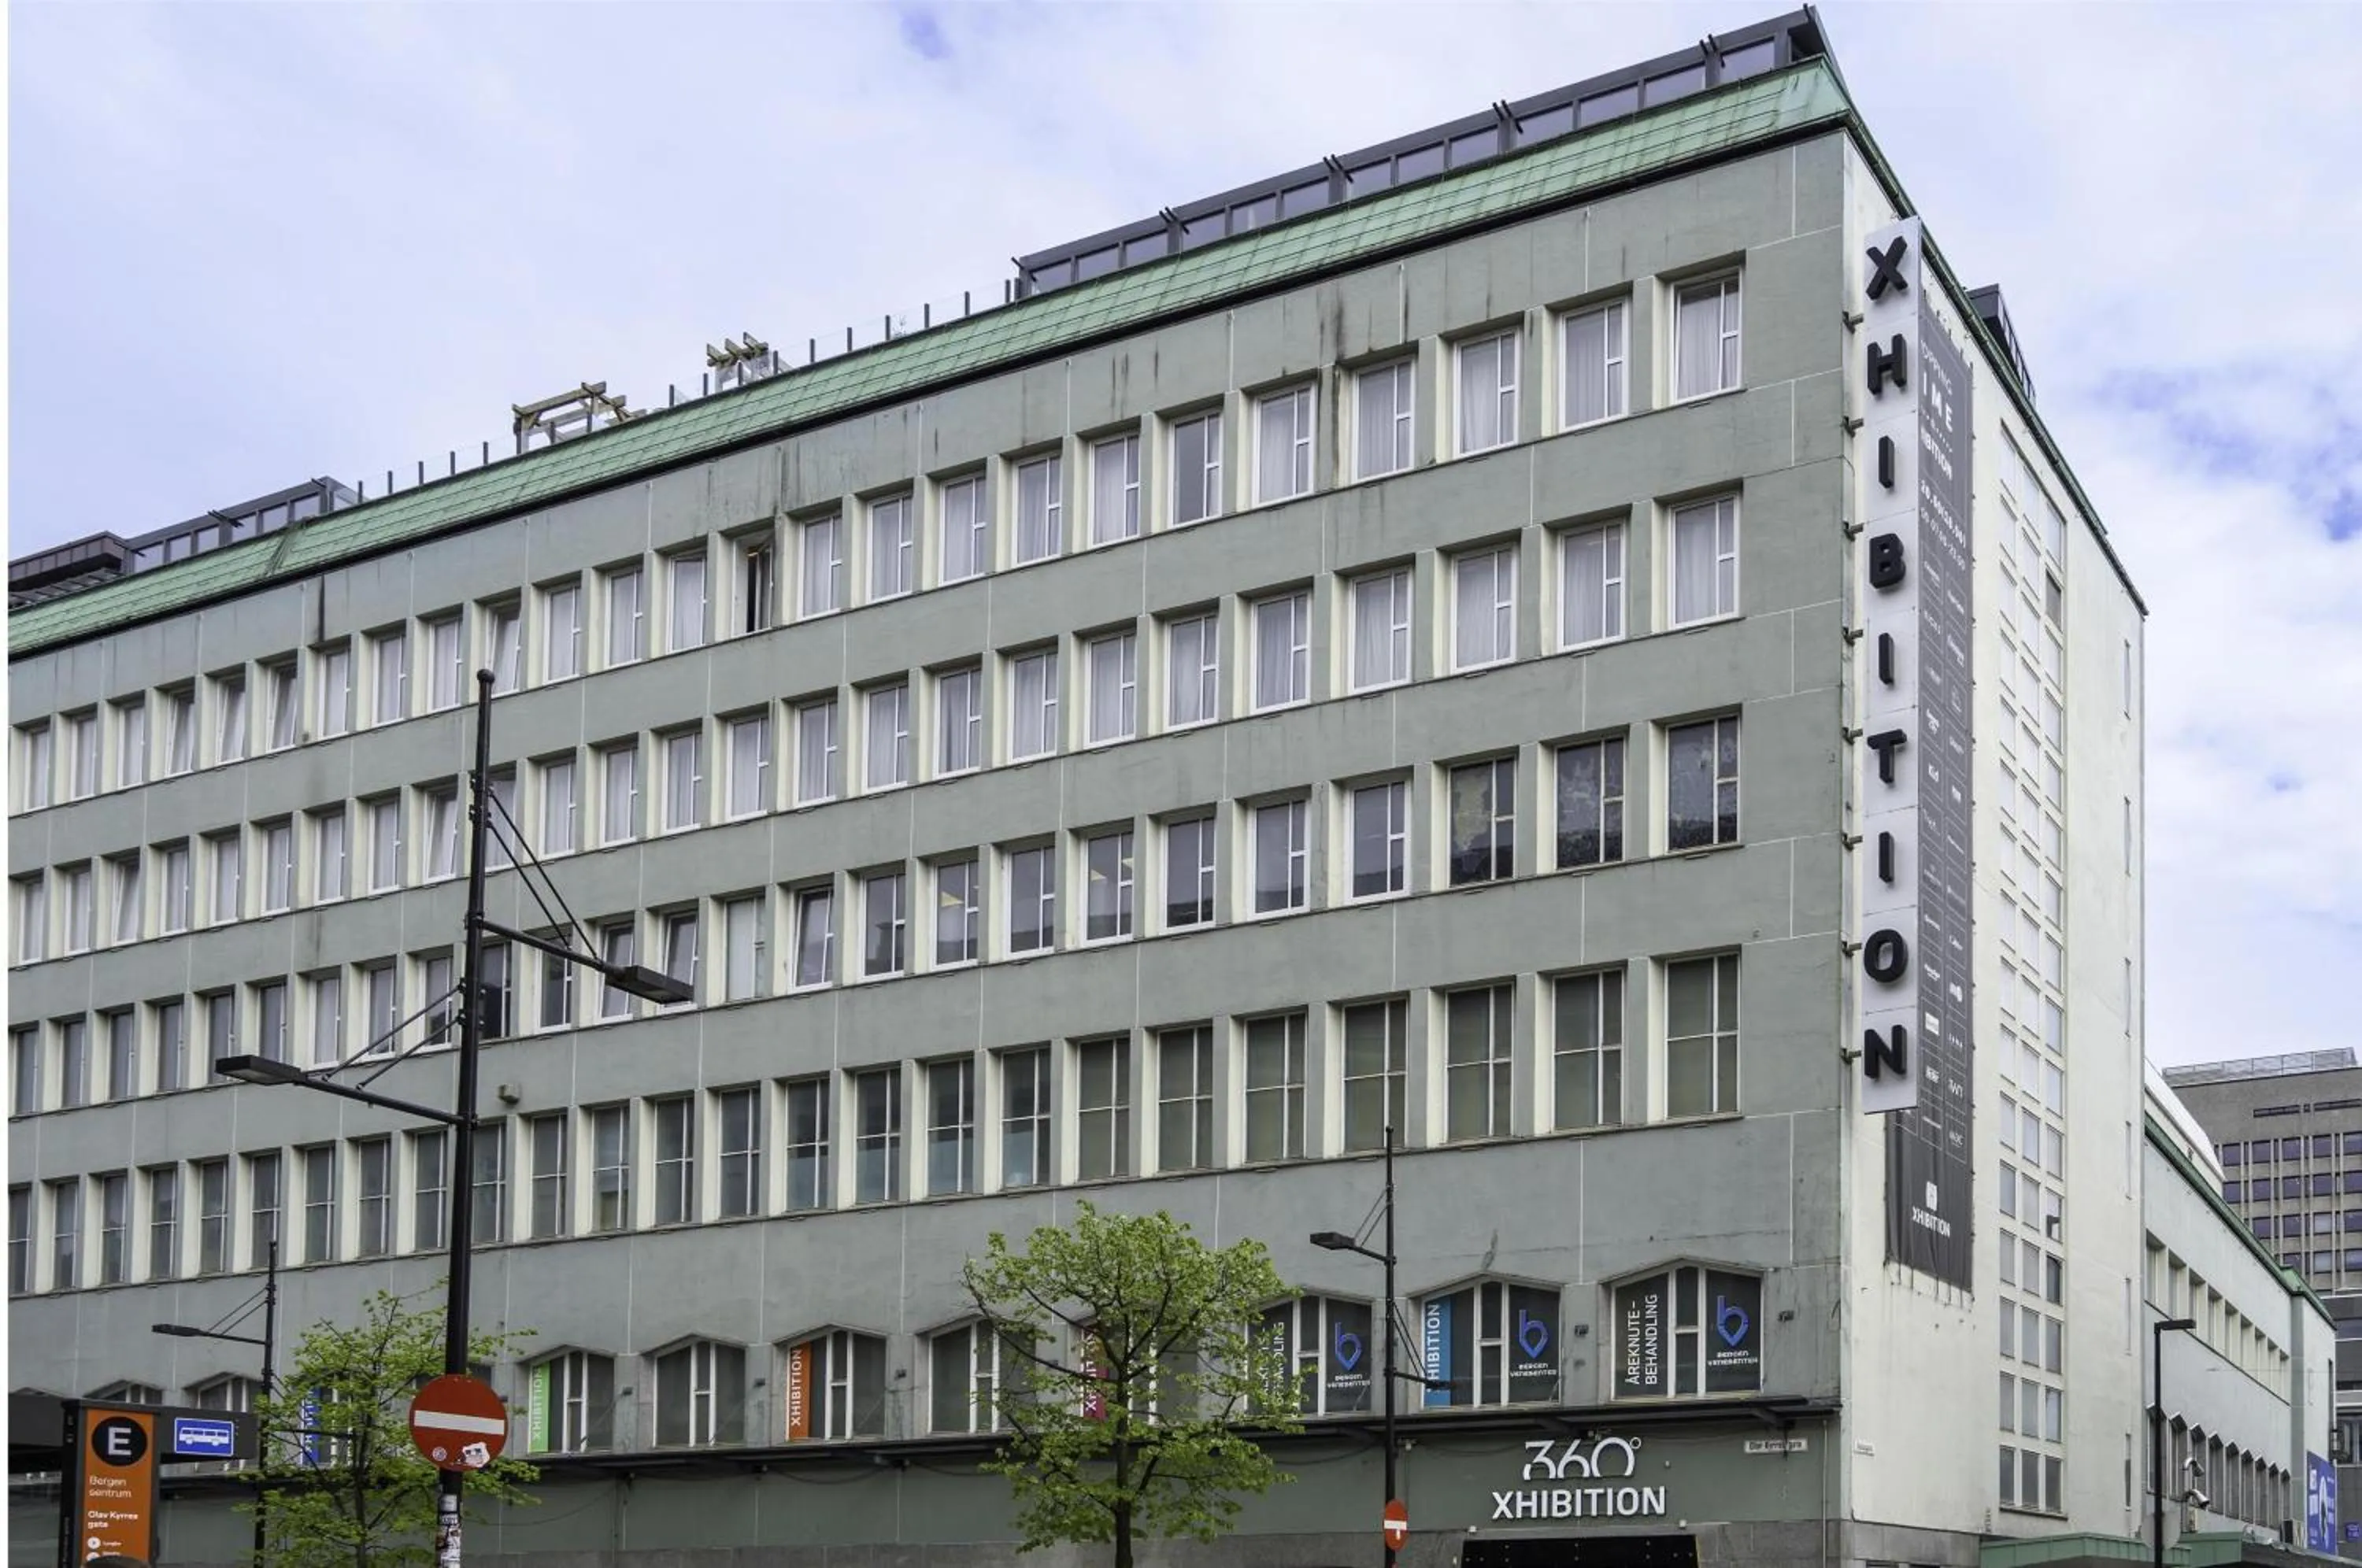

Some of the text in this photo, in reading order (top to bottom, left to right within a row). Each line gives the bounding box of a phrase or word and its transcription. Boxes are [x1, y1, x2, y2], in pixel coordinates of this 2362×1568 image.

[1864, 235, 1908, 1079] XHIBITION
[1427, 1304, 1440, 1392] HIBITION
[1625, 1300, 1640, 1385] ÅREKNUTE-
[1646, 1294, 1657, 1385] BEHANDLING
[790, 1348, 803, 1426] XHIBITION
[108, 1426, 131, 1455] E
[89, 1476, 127, 1487] Bergen
[89, 1488, 131, 1498] sentrum
[1492, 1485, 1666, 1520] XHIBITION
